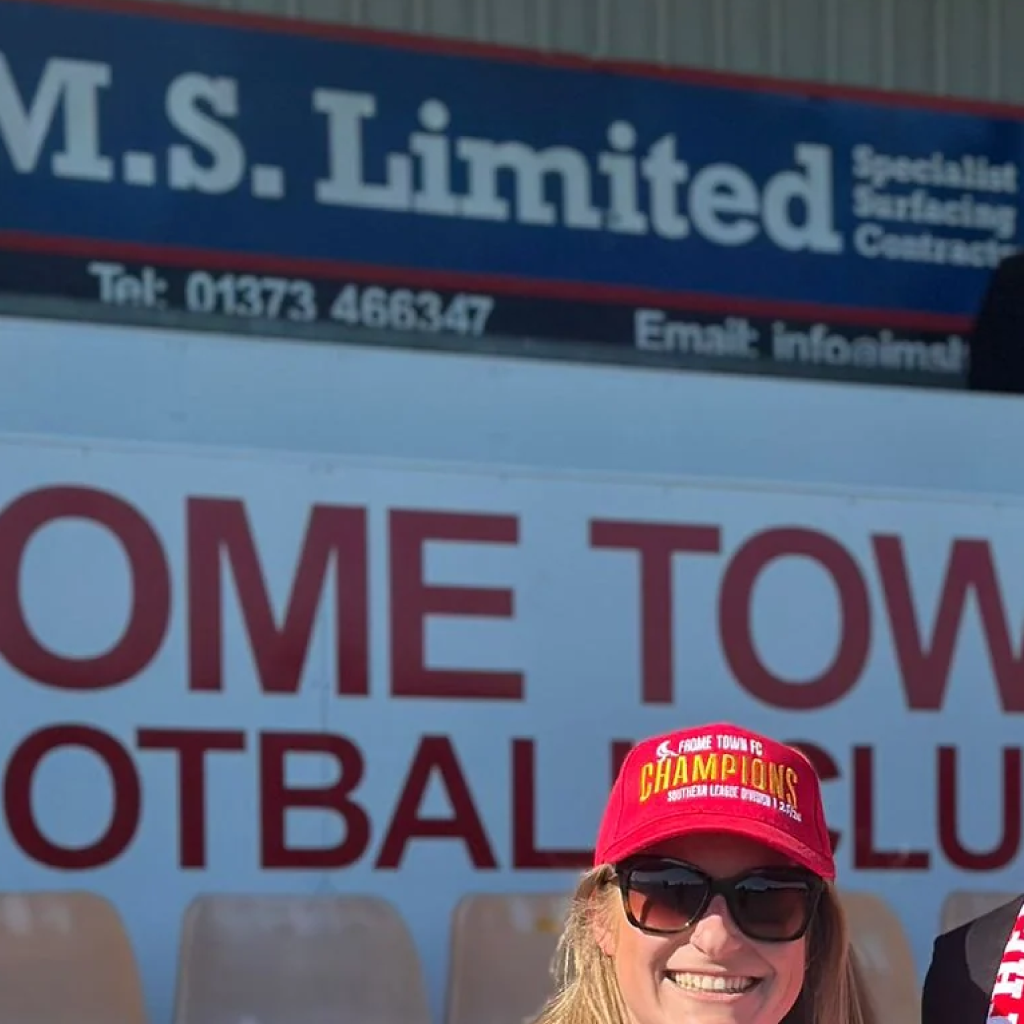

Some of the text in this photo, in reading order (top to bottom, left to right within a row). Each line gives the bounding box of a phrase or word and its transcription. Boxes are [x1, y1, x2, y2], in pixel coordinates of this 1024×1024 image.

[312, 87, 843, 255] Limited
[852, 144, 1017, 194] Specialist
[852, 184, 1016, 239] Surfacing
[854, 222, 1020, 269] Contract
[88, 261, 495, 336] Tel: 01373 466347
[633, 309, 760, 358] Email:
[0, 484, 525, 702] OME
[678, 734, 763, 757] FROME TOWN FC
[639, 753, 798, 808] CHAMPIONS
[667, 784, 708, 802] SOUTHERN
[710, 784, 740, 799] LEAGUE
